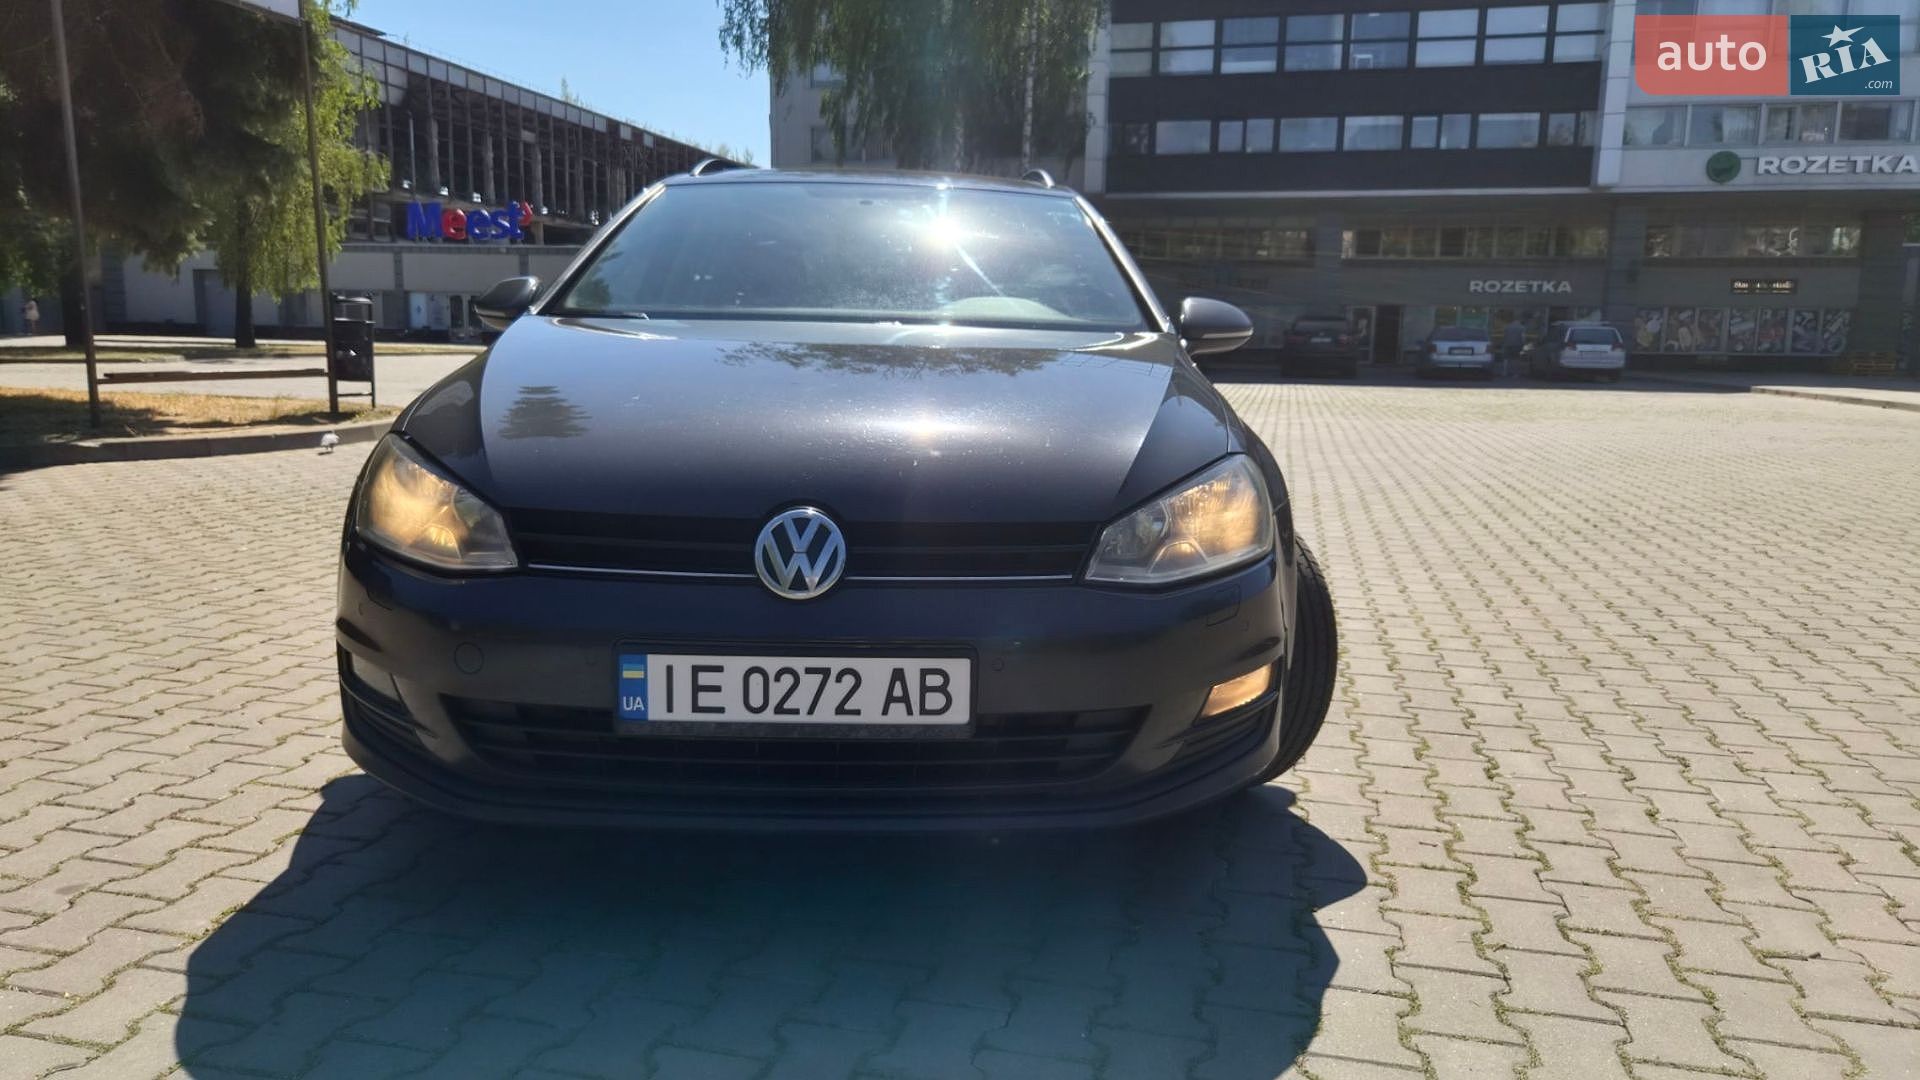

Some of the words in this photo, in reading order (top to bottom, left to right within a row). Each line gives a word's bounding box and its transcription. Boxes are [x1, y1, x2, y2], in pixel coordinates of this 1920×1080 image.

[1757, 154, 1920, 176] ROZETKA
[406, 200, 524, 240] Meest
[1469, 280, 1572, 293] ROZETKA
[665, 664, 726, 714] IE
[742, 666, 862, 716] 0272
[881, 667, 953, 716] AB
[623, 697, 645, 711] UA
